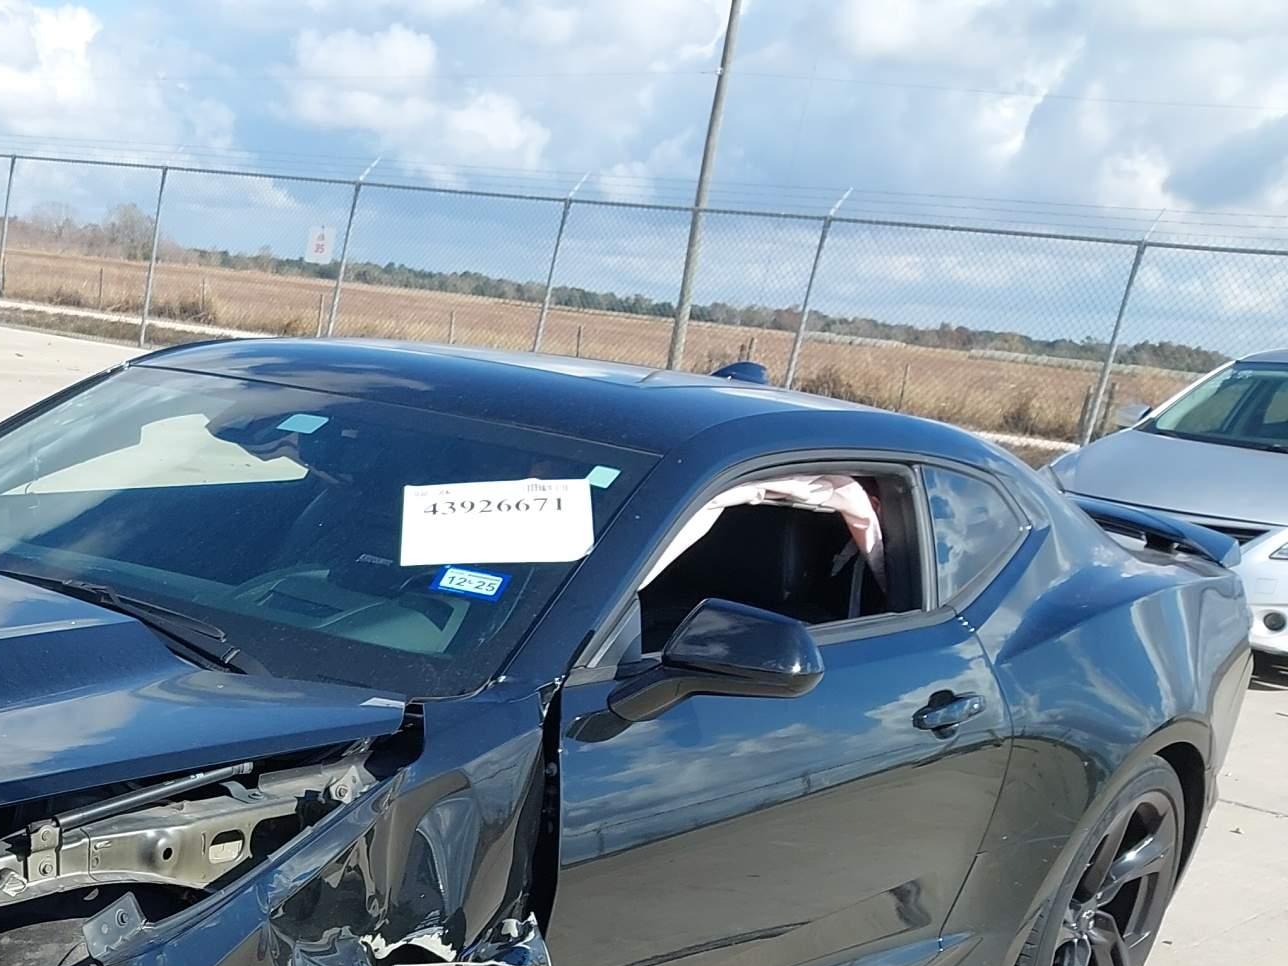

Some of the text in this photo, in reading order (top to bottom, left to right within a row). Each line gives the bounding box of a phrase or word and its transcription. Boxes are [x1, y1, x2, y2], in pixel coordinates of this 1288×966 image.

[423, 497, 563, 516] 43926671
[448, 575, 468, 587] 12
[474, 580, 498, 593] 25
